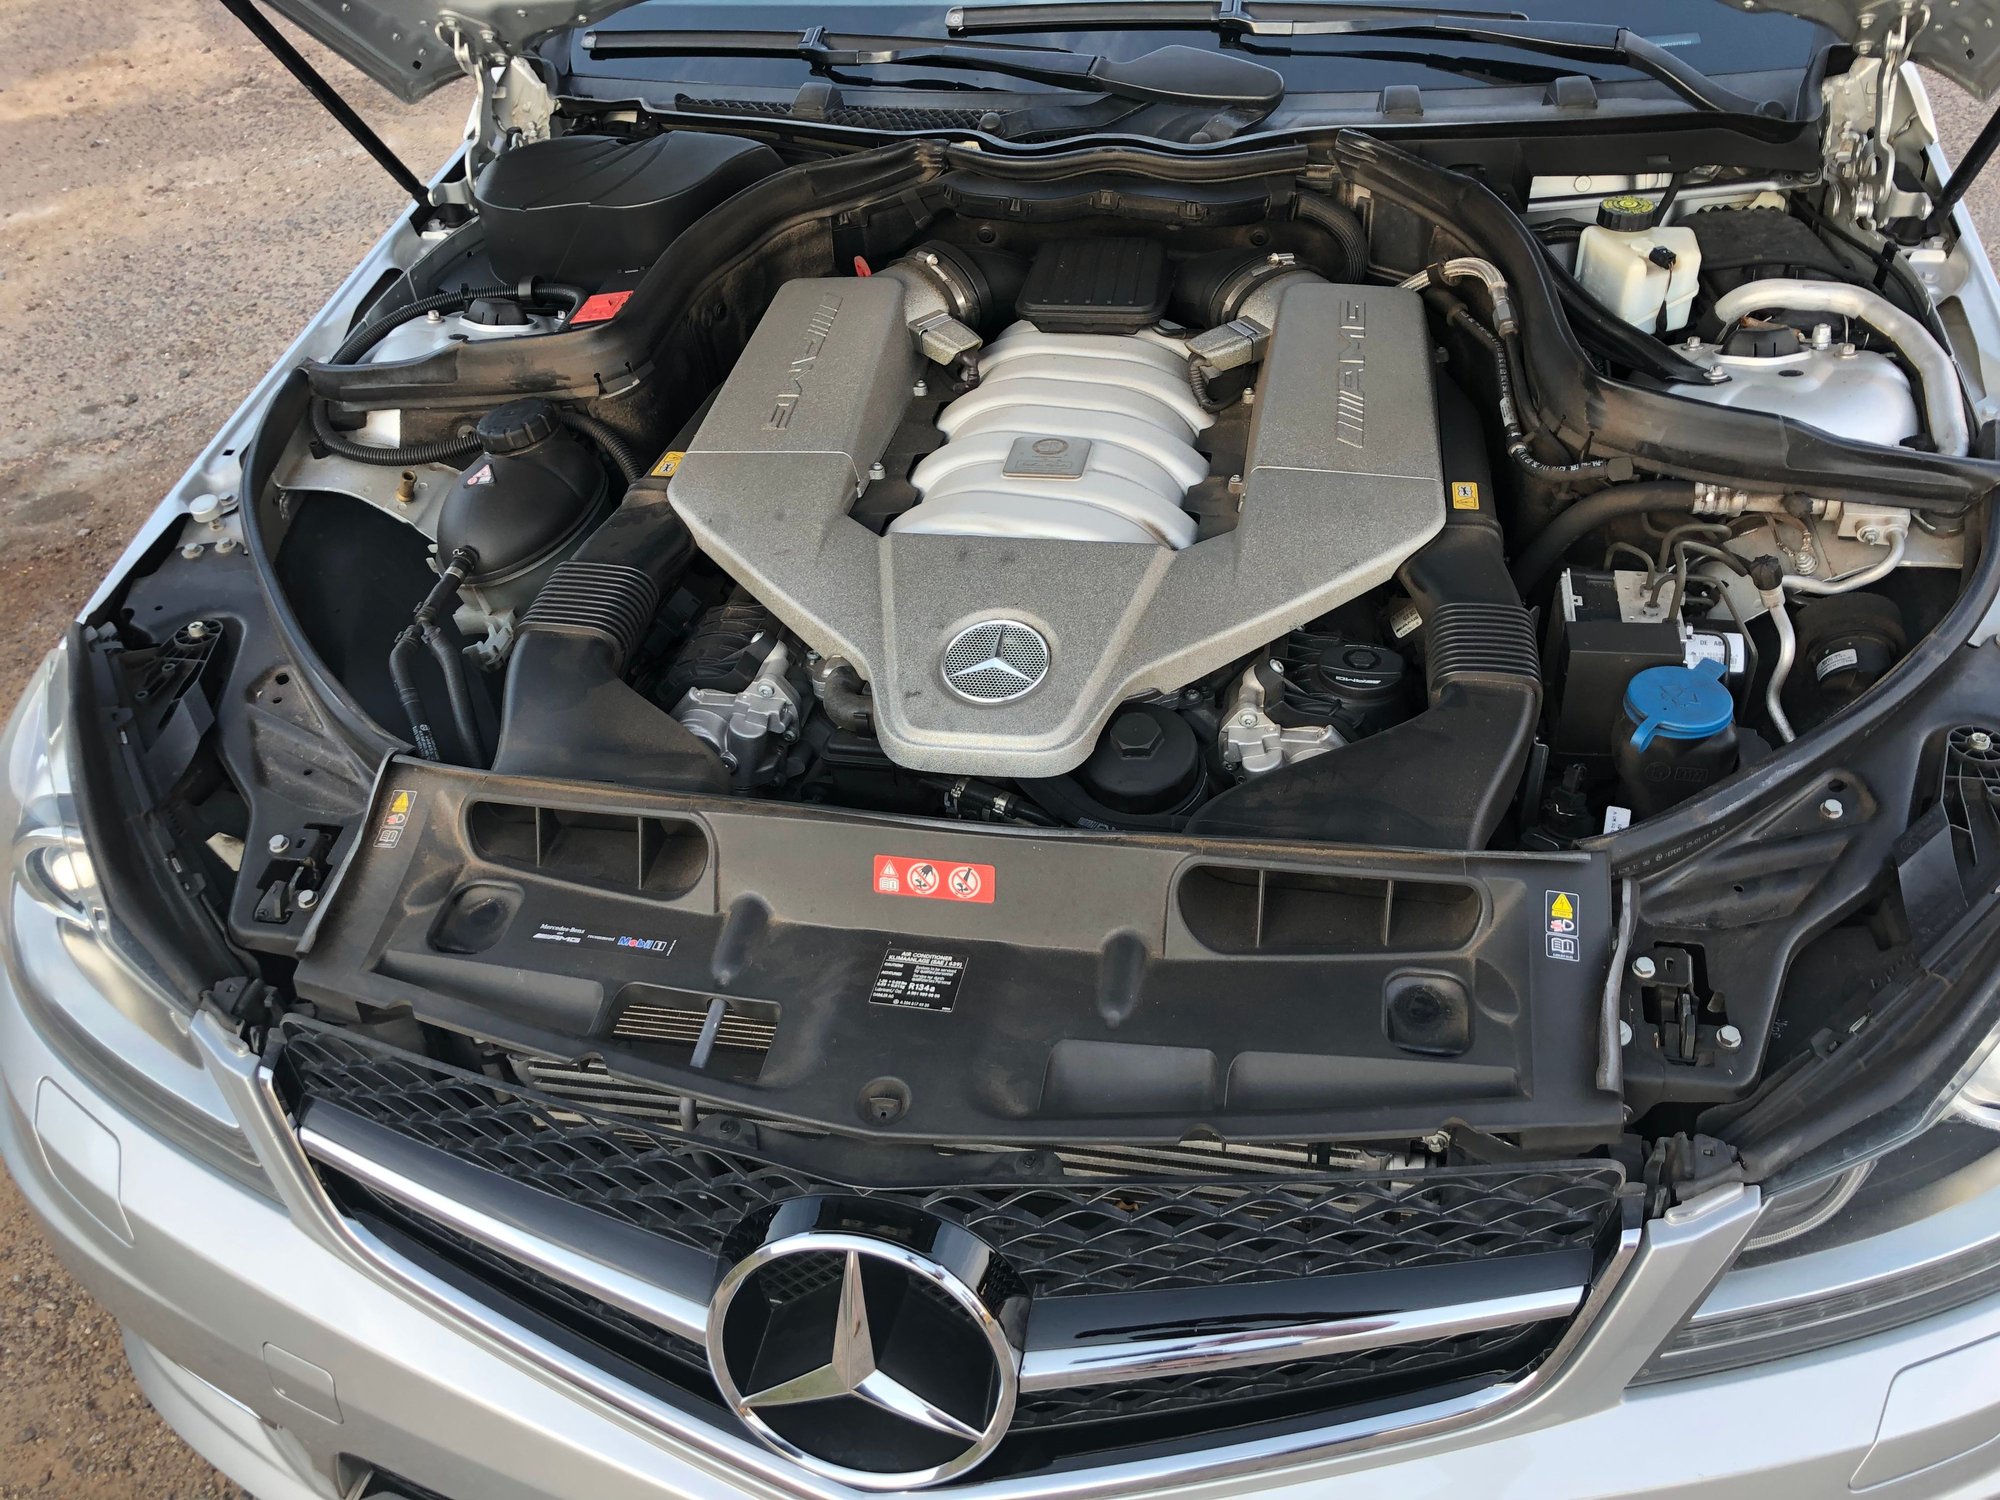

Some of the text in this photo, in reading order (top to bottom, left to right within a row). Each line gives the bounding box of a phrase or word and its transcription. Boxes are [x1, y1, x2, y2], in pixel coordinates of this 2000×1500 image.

[540, 923, 585, 934] Mercedes-Benz
[617, 936, 654, 950] Mobil
[888, 955, 930, 964] KLIMAANLAGE
[912, 952, 953, 961] CONDITIONER
[908, 982, 936, 992] R134a
